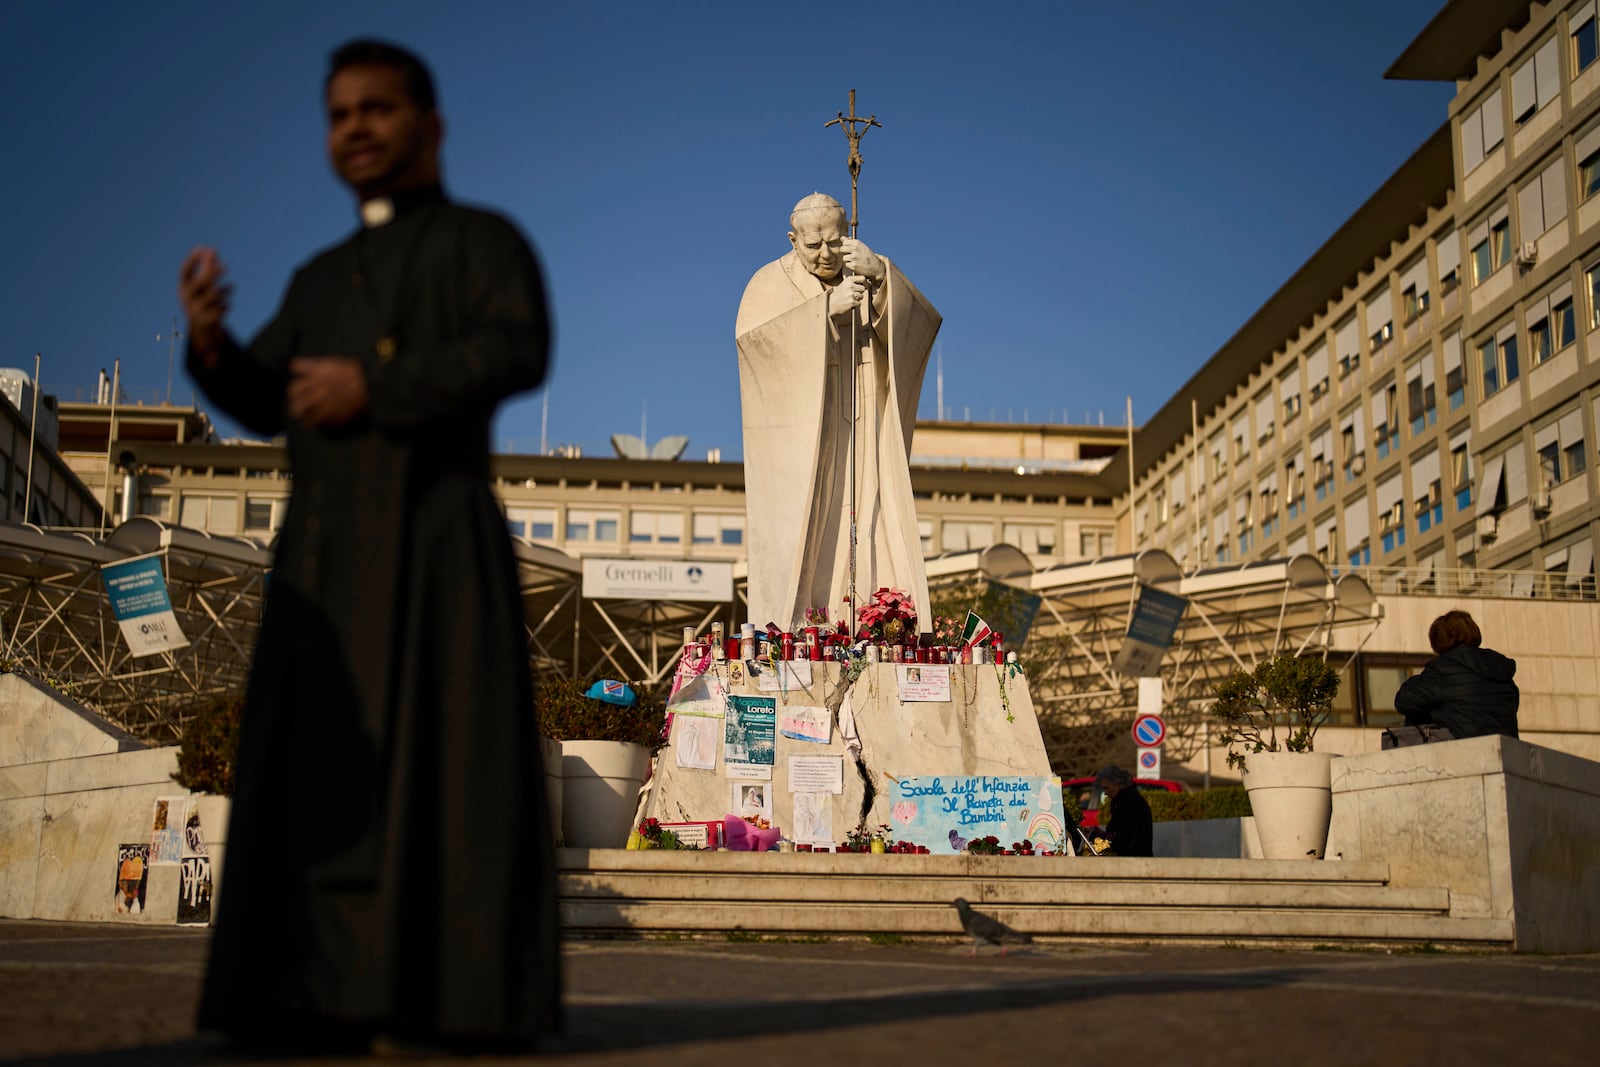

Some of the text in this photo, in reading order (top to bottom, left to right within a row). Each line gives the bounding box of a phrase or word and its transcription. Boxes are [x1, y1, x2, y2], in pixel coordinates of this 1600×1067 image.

[605, 563, 673, 582] Gemelli
[747, 705, 774, 714] Loreto
[900, 778, 947, 797] Scuola
[965, 793, 1004, 809] Pianeta
[1009, 793, 1027, 806] dei
[957, 808, 1006, 825] Bambini
